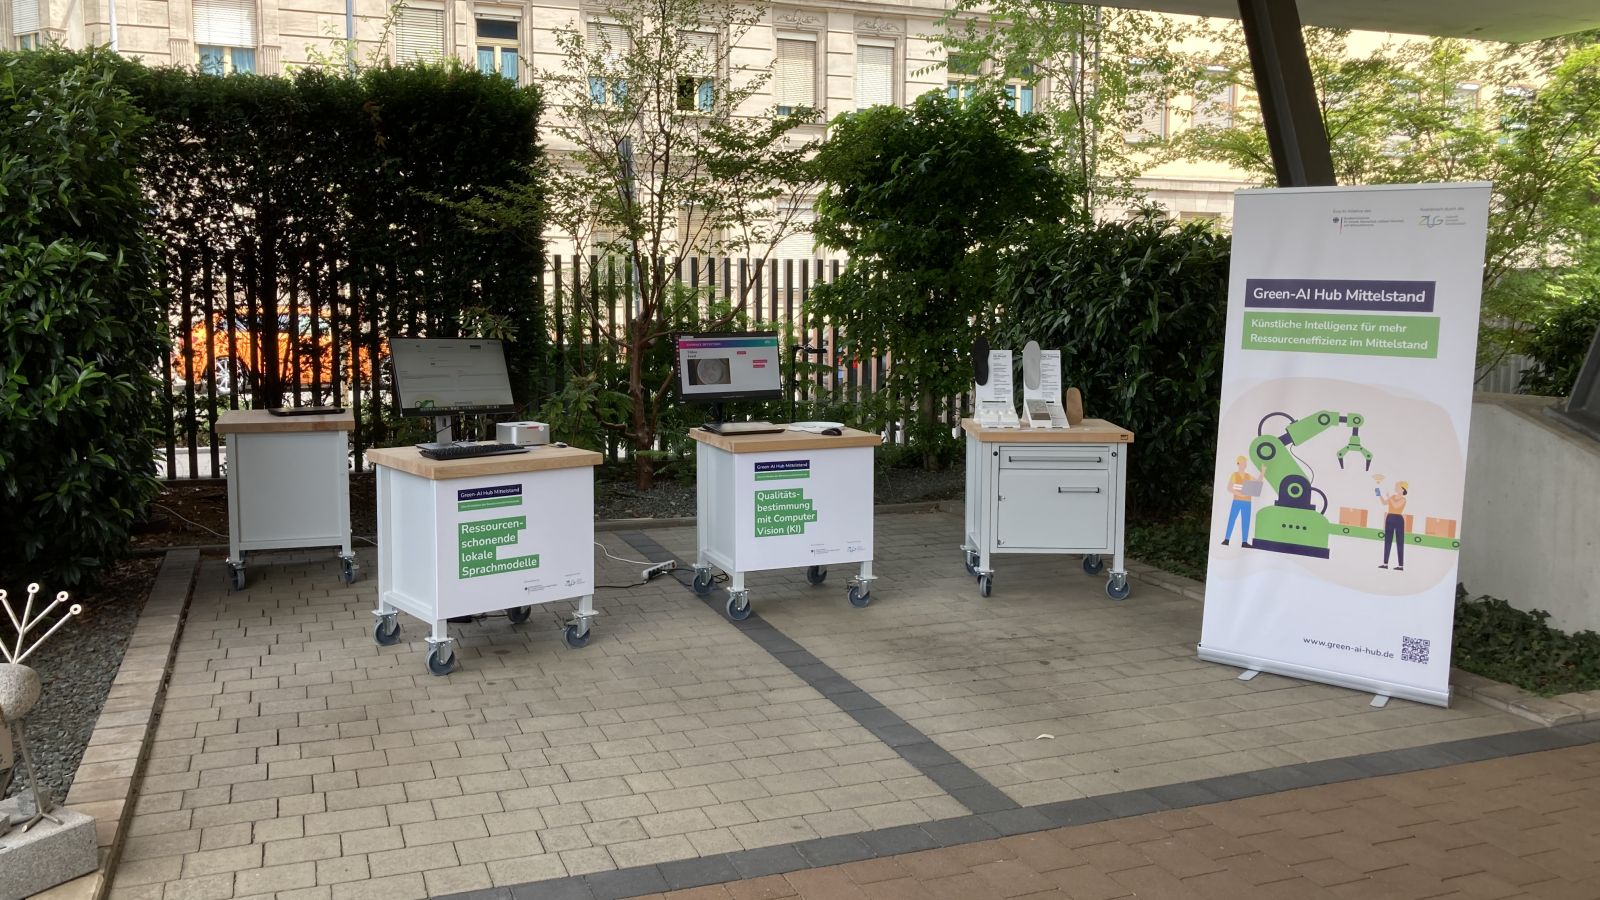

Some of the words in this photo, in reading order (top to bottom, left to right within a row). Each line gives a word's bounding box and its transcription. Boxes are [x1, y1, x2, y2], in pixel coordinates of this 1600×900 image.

[1253, 287, 1311, 301] Green-AI
[1314, 288, 1342, 301] Hub
[1345, 289, 1426, 303] Mittelstand
[1251, 318, 1302, 330] Künstliche
[1304, 320, 1358, 333] Intelligenz
[1360, 321, 1376, 332] für
[1379, 323, 1407, 333] mehr
[1250, 333, 1347, 347] Ressourceneffizienz
[1349, 337, 1363, 347] im
[1365, 338, 1428, 351] Mittelstand
[757, 492, 800, 501] Qualitäts-
[757, 502, 810, 512] bestimmung
[757, 515, 771, 523] mit
[773, 513, 815, 524] Computer
[461, 520, 524, 534] Ressourcen-
[757, 527, 784, 535] Vision
[787, 525, 801, 535] (KI)
[461, 534, 516, 548] schonende
[461, 550, 493, 562] lokale
[462, 557, 537, 578] Sprachmodelle
[1303, 637, 1395, 660] www.green-ai-hub.de
